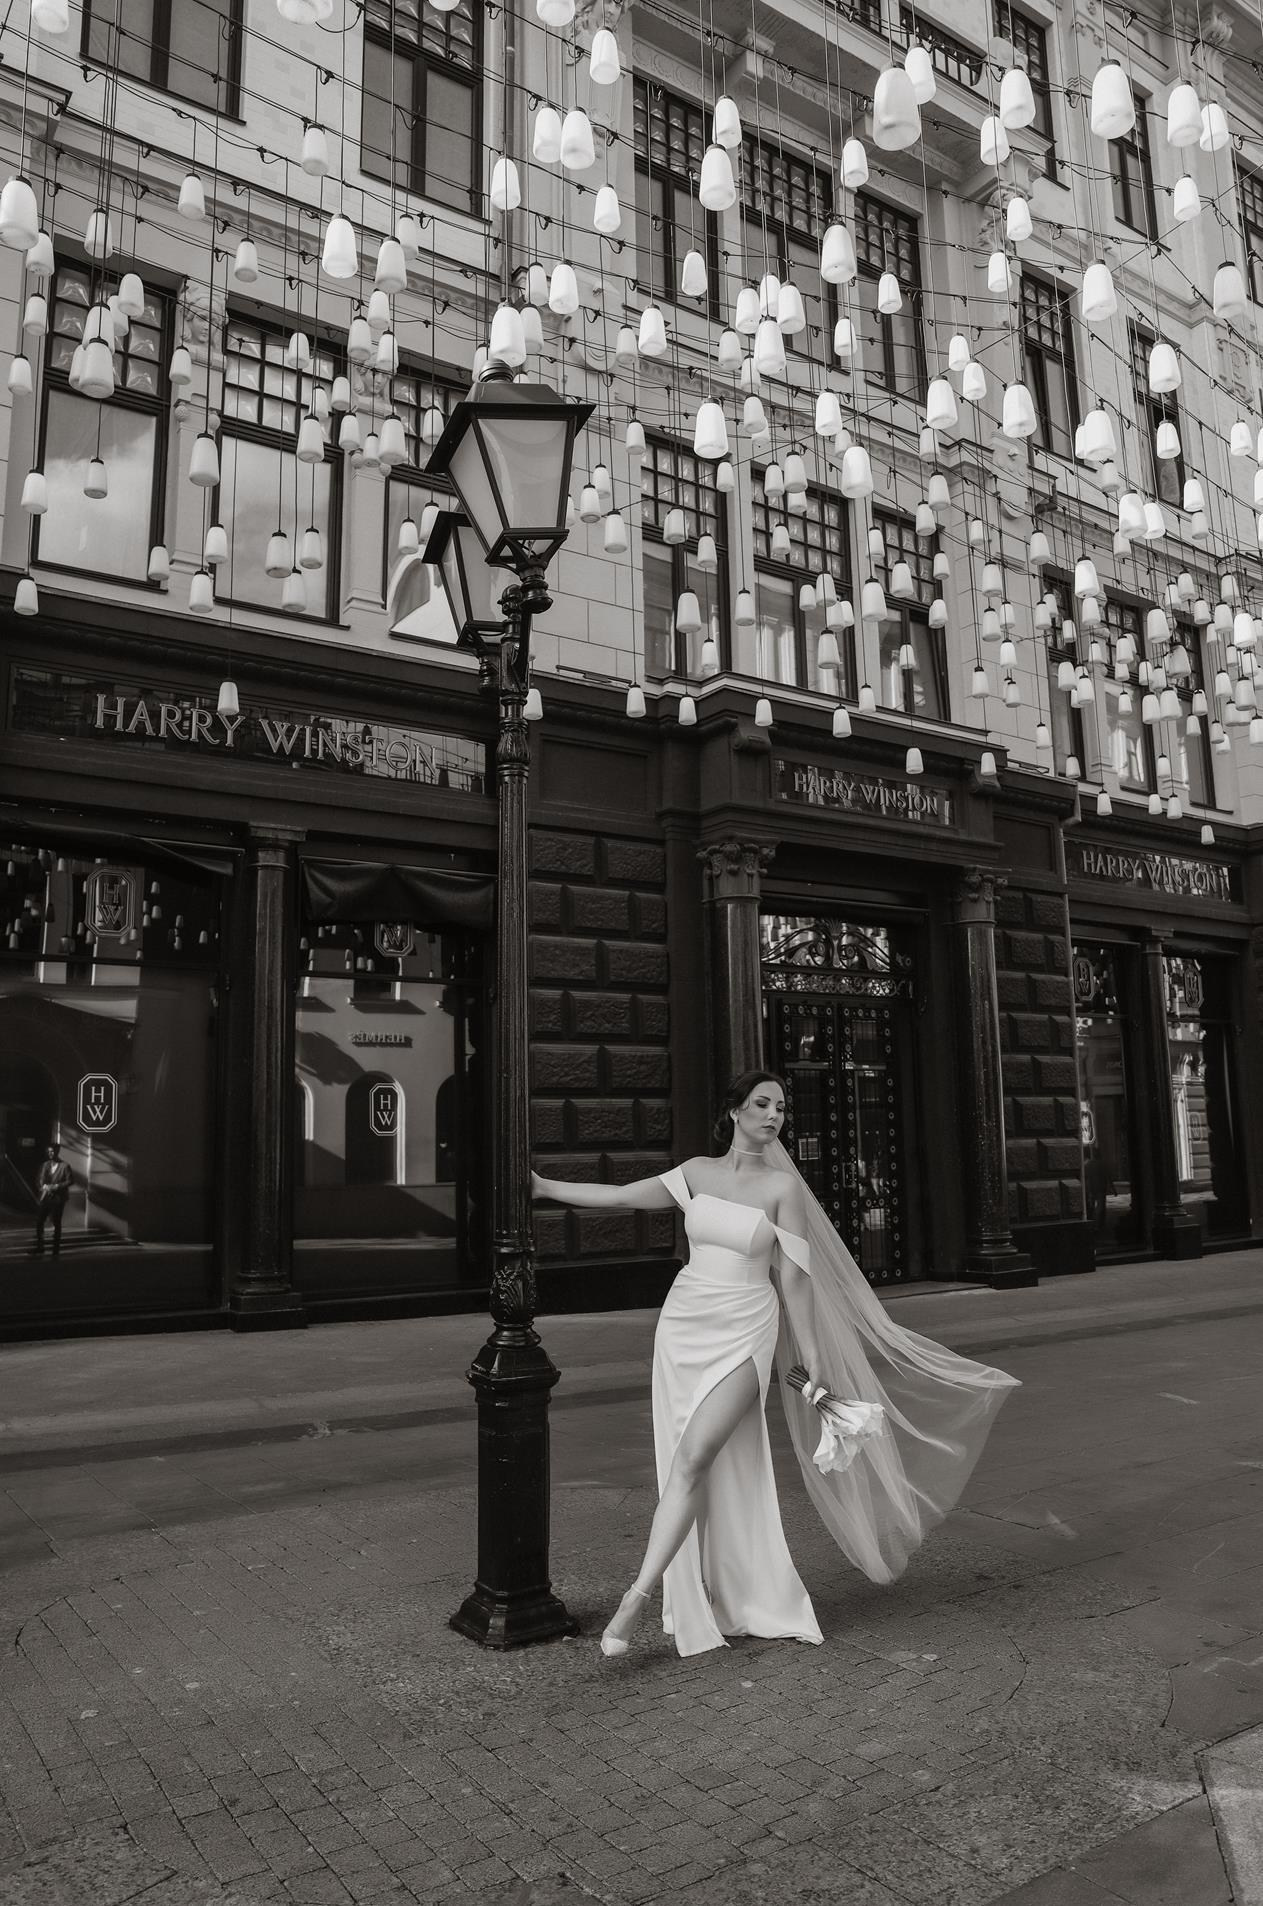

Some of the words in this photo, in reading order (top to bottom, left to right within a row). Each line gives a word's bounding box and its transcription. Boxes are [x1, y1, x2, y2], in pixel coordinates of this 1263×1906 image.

[94, 693, 246, 748] HARRY
[259, 718, 440, 777] WINSTON
[793, 770, 856, 801] HARRY
[859, 783, 939, 816] WINSTON
[1082, 849, 1141, 880] HARRY
[1144, 860, 1218, 892] WINSTON
[91, 1086, 105, 1103] H
[380, 1094, 391, 1110] H
[86, 1105, 110, 1121] W
[376, 1112, 395, 1126] W
